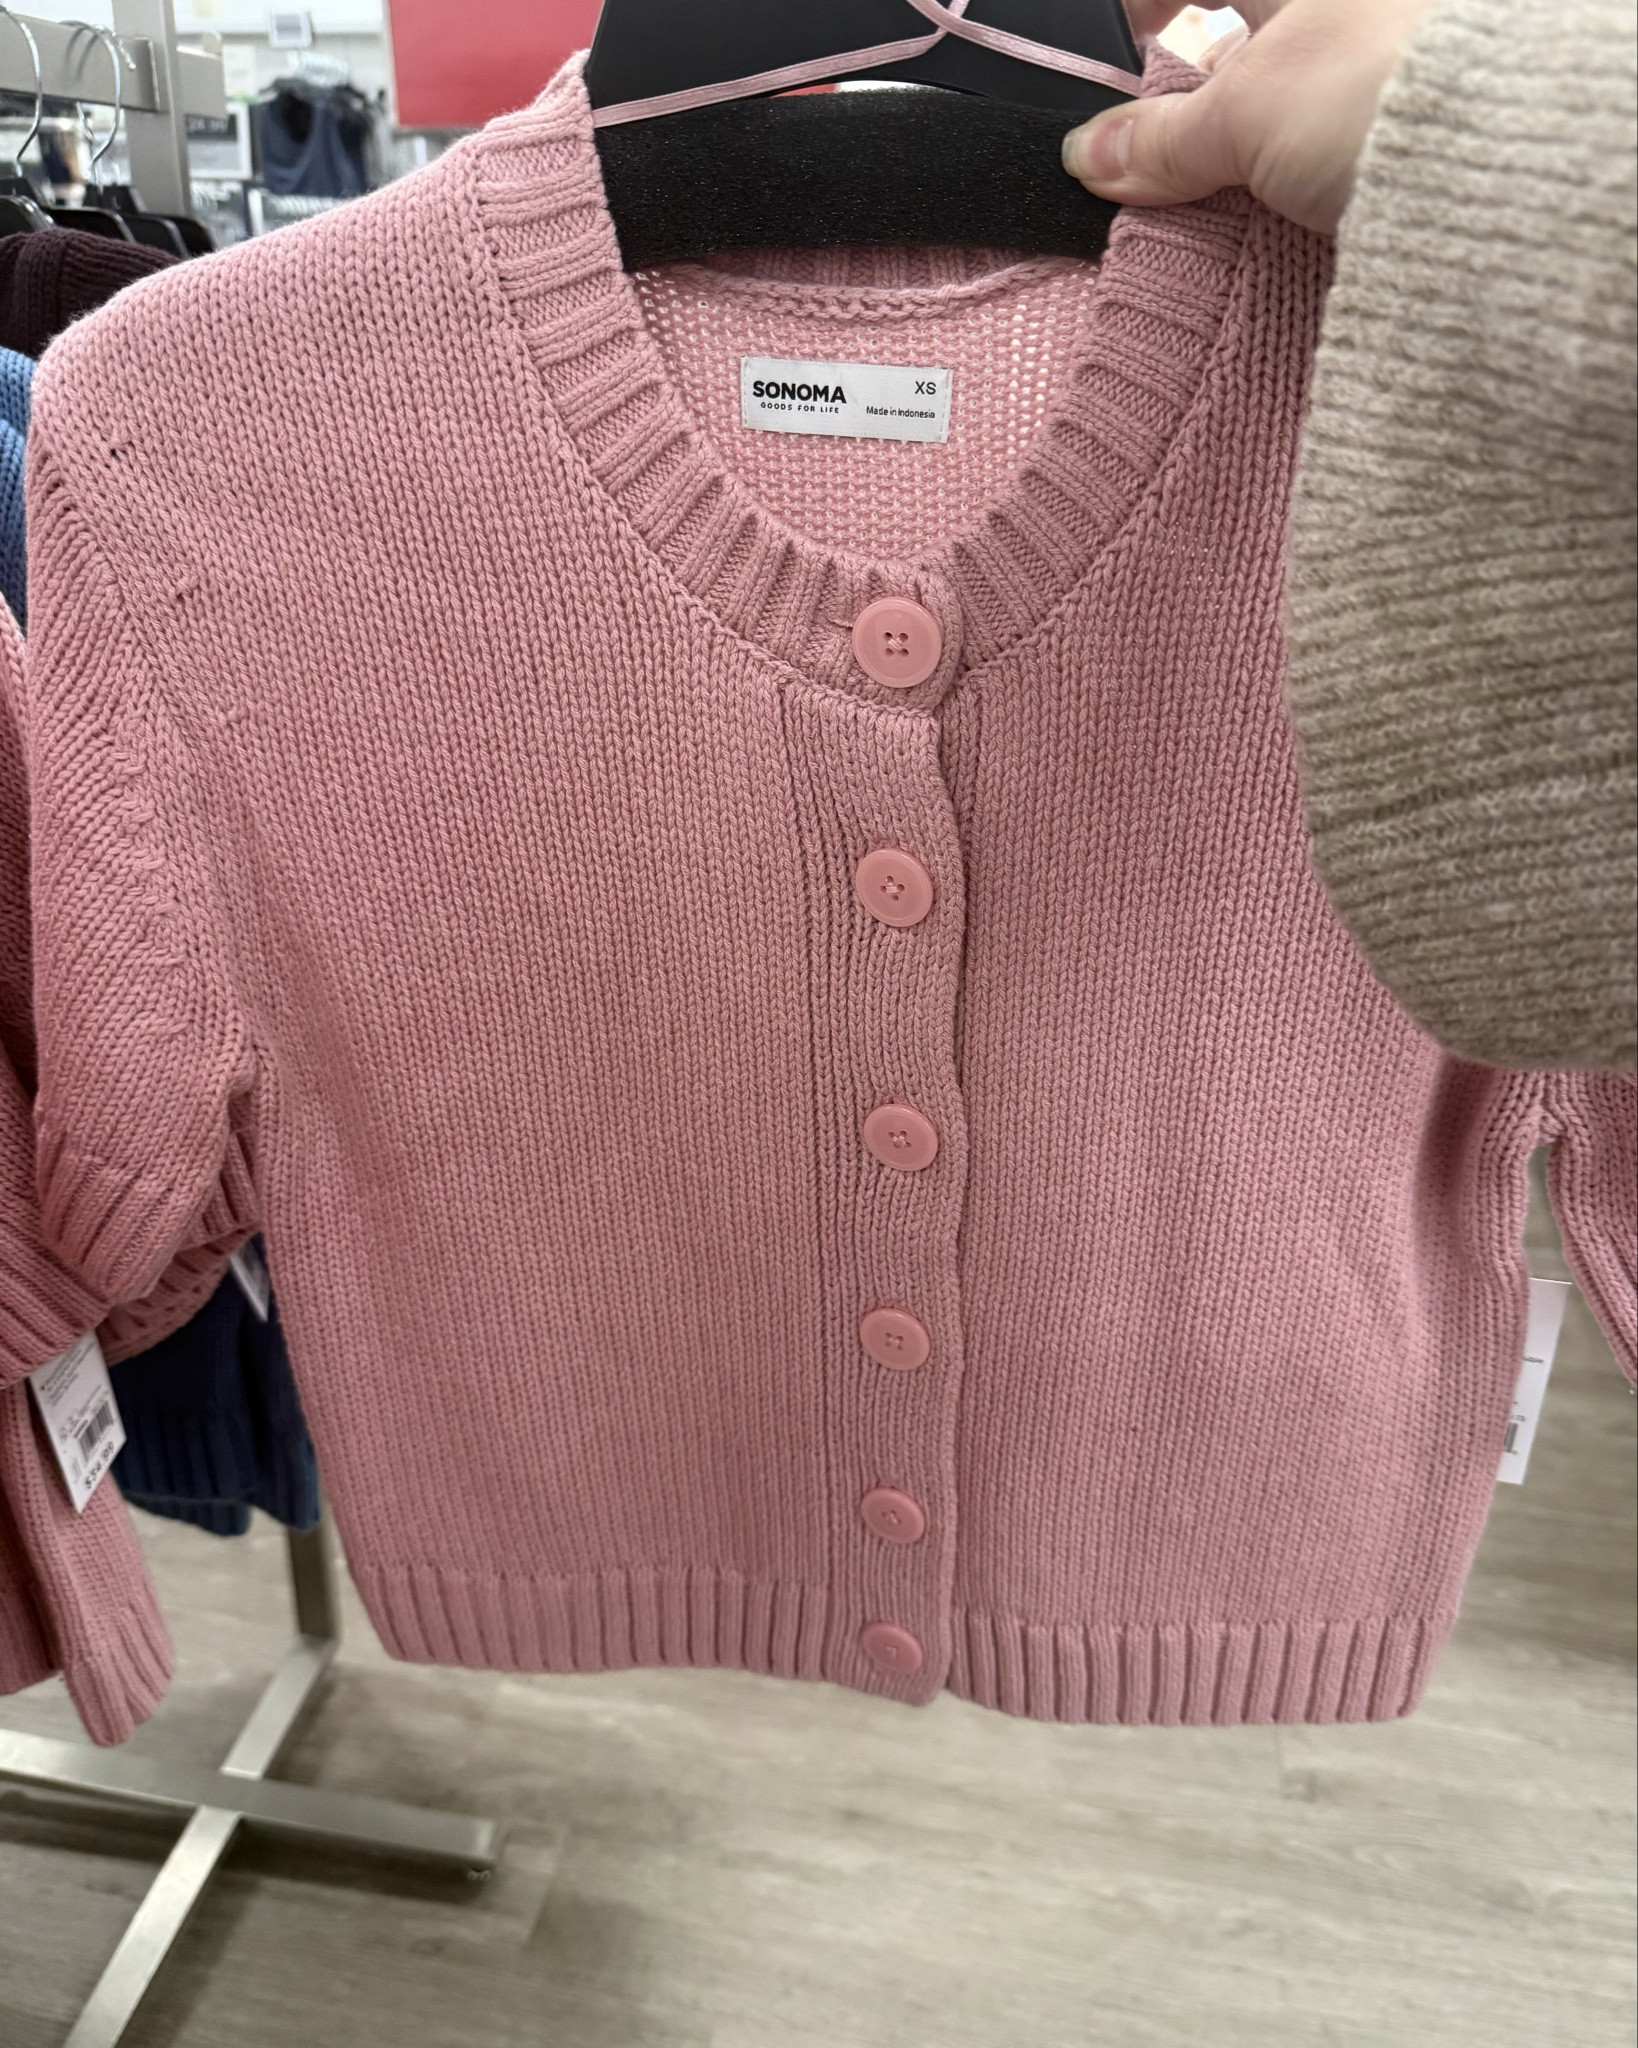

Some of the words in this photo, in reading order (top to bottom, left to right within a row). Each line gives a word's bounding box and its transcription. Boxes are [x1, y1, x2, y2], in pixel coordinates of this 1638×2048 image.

[752, 380, 847, 404] SONOMA
[914, 381, 937, 395] XS
[760, 401, 793, 411] GOODS
[866, 405, 889, 416] Made
[889, 407, 897, 416] in
[898, 408, 936, 419] Indonesia
